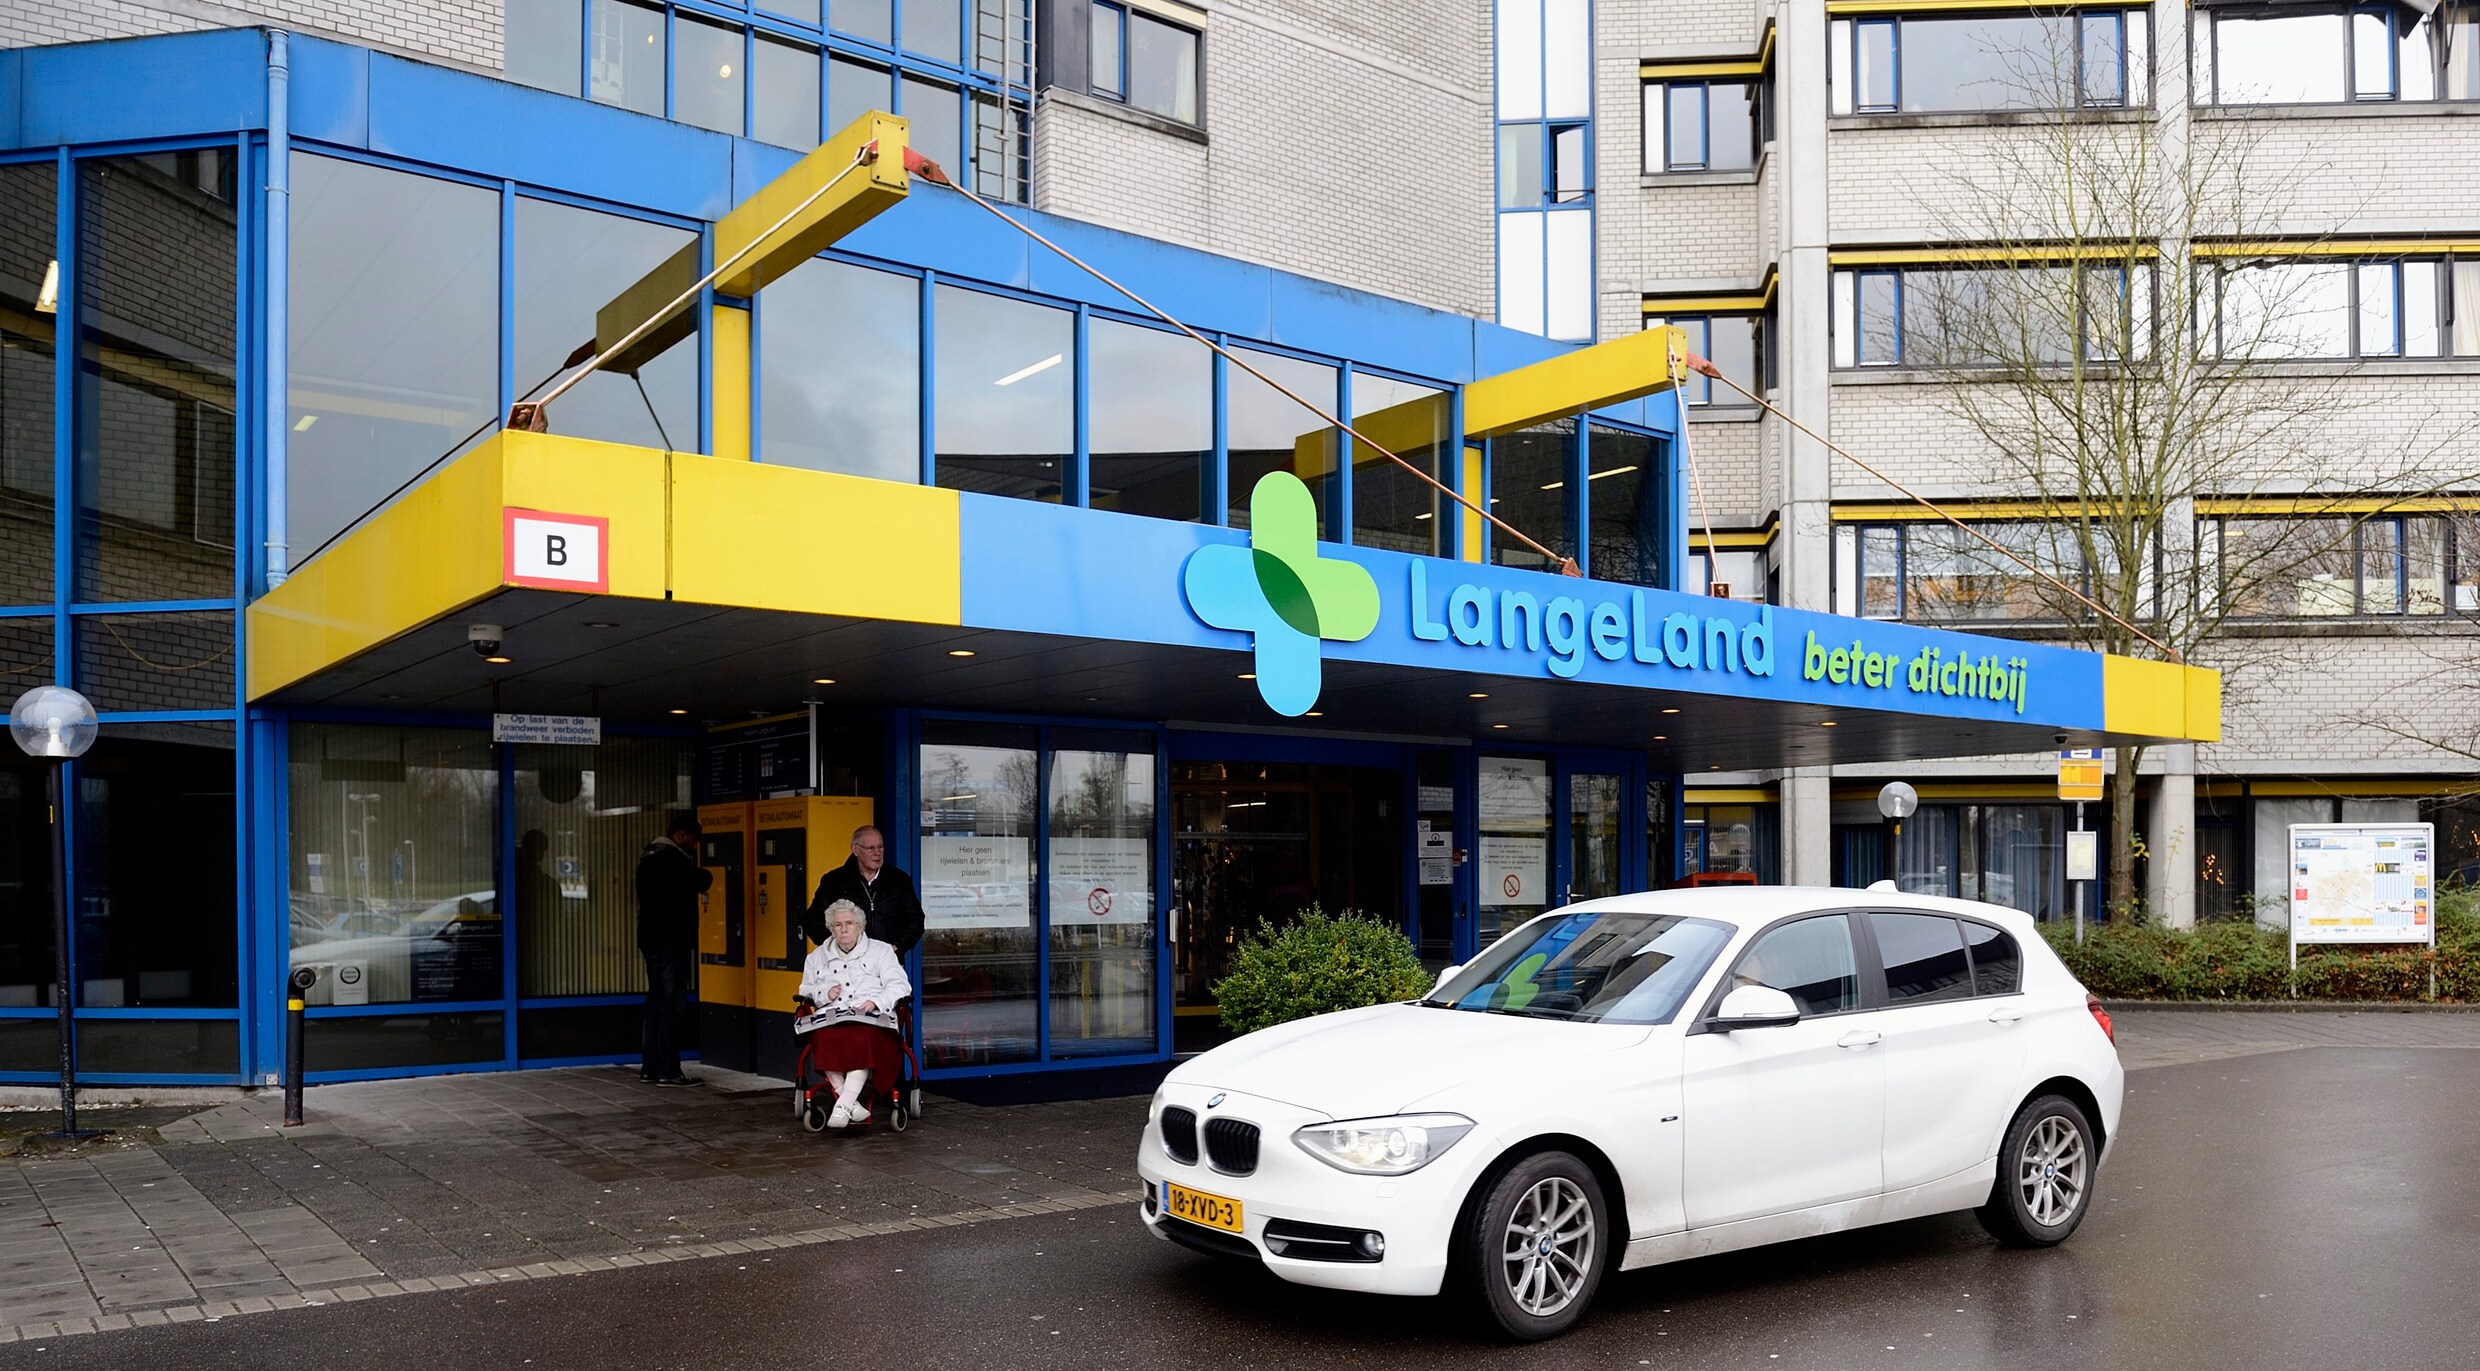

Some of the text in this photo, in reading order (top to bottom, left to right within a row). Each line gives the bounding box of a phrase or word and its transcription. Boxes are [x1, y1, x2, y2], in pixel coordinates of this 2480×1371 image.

[546, 534, 567, 566] B
[1411, 557, 1774, 678] LangeLand
[1803, 630, 2028, 714] beter dichtbij
[510, 714, 525, 723] Op
[529, 715, 547, 723] last
[572, 717, 585, 725] de
[500, 723, 595, 735] brandweer verboden
[500, 733, 537, 742] rijwielen
[975, 847, 992, 855] geen
[940, 858, 968, 866] rijwielen
[969, 857, 975, 865] &
[961, 869, 990, 878] plaatsen
[1172, 1189, 1233, 1226] 18-XVD-3
